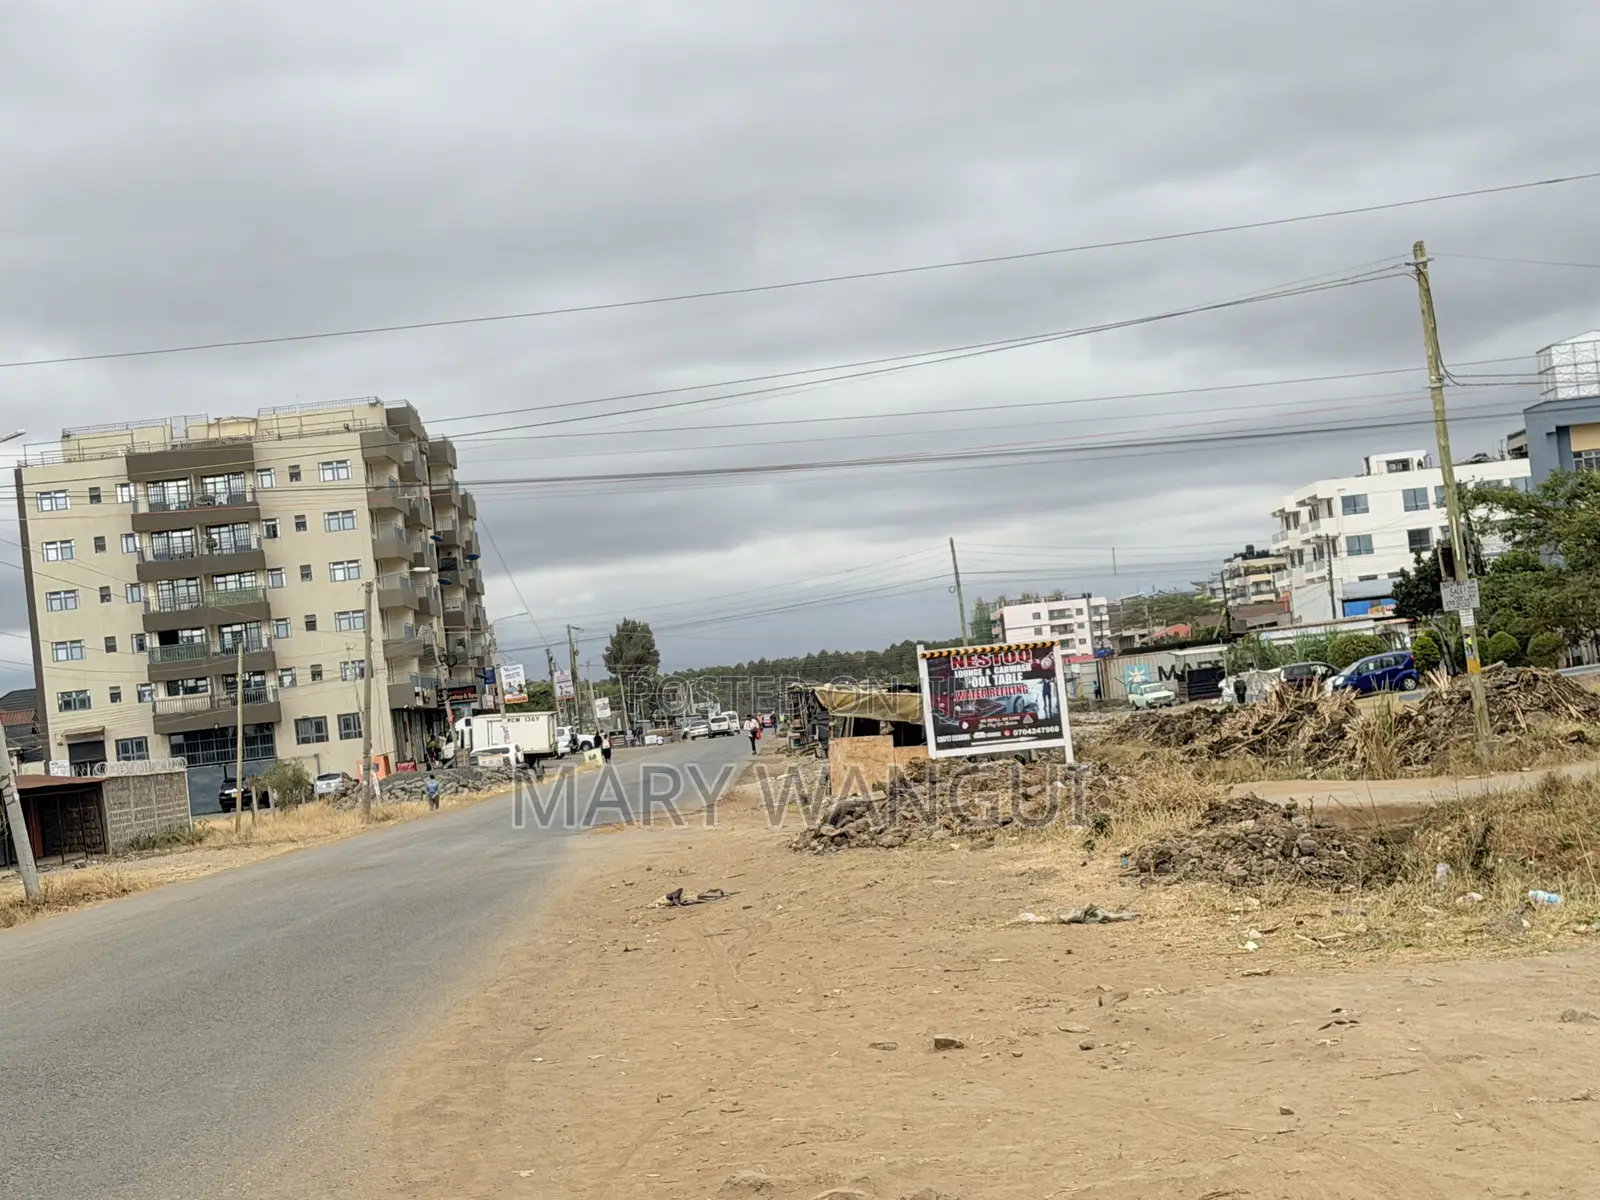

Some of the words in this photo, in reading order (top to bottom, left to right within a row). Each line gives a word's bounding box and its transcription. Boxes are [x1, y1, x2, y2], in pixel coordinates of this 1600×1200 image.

[954, 668, 983, 678] LOUNGE
[993, 663, 1032, 674] CARWASH
[965, 675, 991, 688] POOL
[992, 672, 1023, 685] TABLE
[955, 688, 988, 702] WATER
[988, 684, 1029, 698] REFILING
